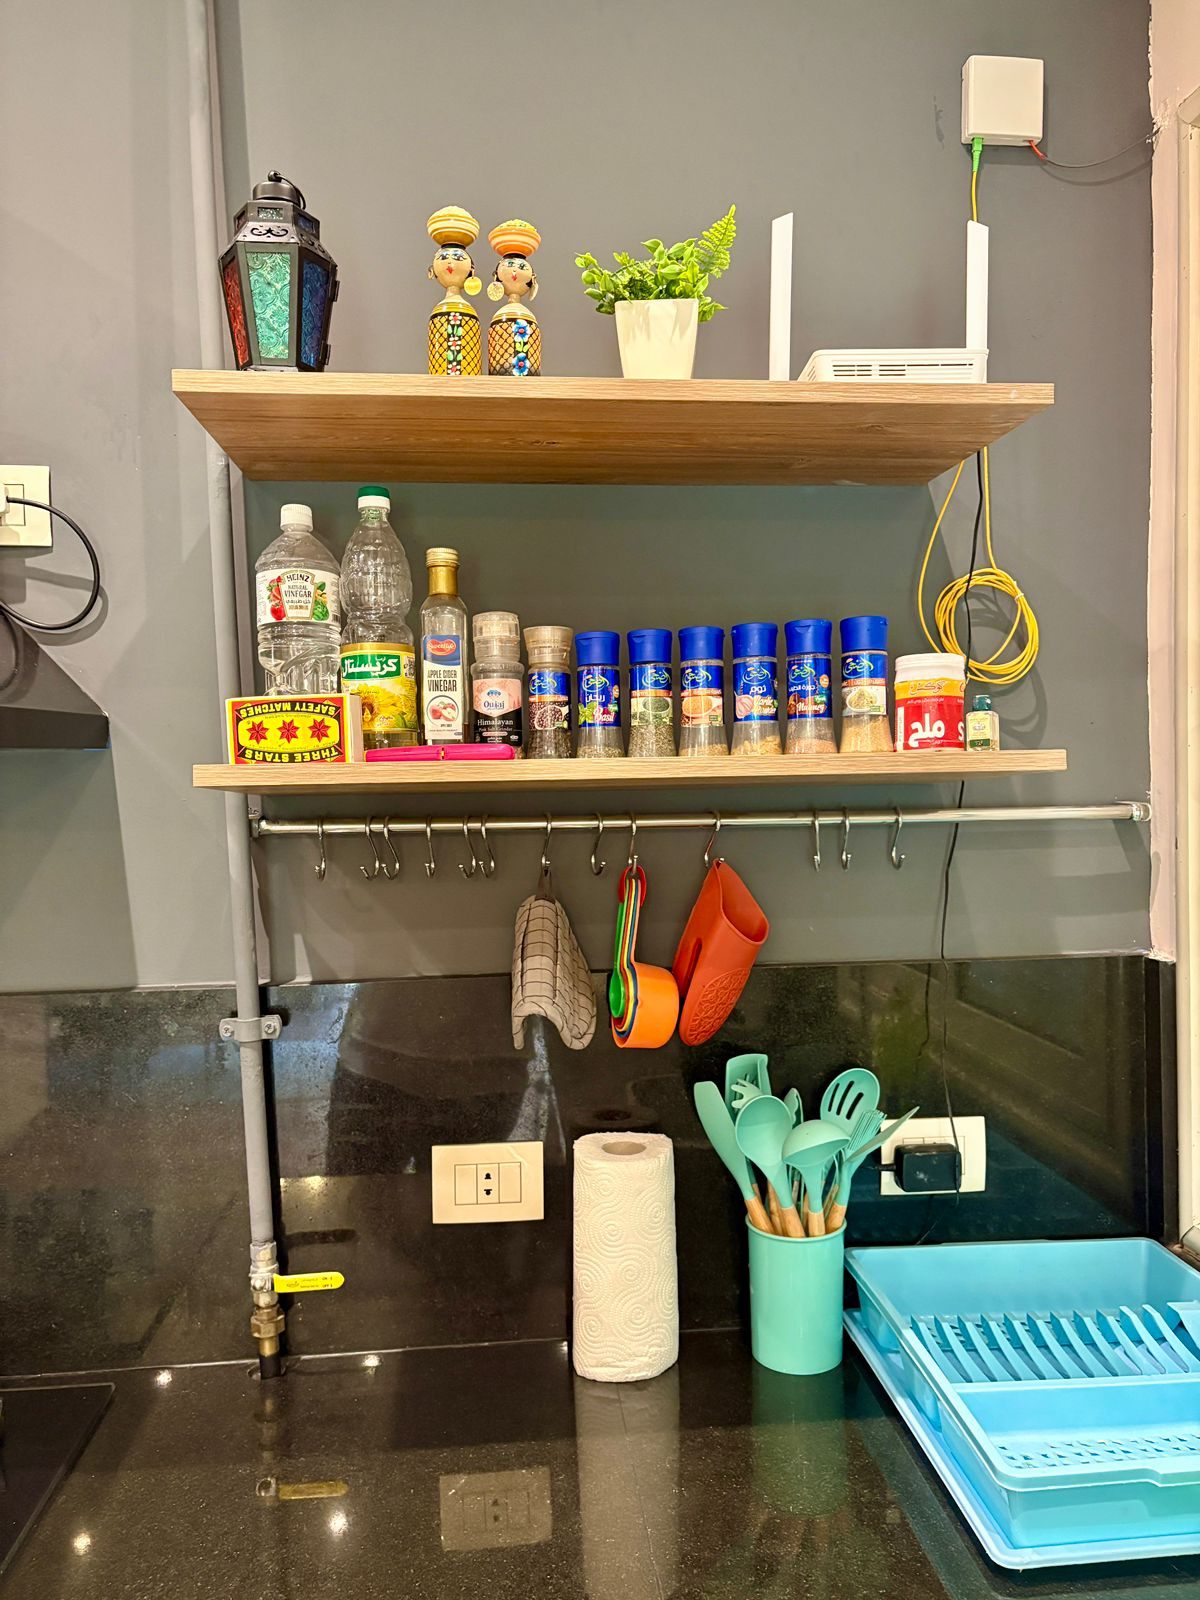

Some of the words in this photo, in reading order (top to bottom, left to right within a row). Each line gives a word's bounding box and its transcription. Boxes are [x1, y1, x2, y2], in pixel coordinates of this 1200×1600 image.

[286, 573, 310, 583] HEINZ
[284, 590, 312, 598] VINEGAR
[342, 656, 399, 677] كريستال
[427, 669, 442, 679] APPLE
[442, 669, 458, 679] CIDER
[427, 679, 458, 692] VINEGAR
[239, 702, 292, 718] MATCHES
[294, 702, 337, 715] SAFETY
[477, 719, 514, 727] Himalayan
[907, 713, 946, 748] ملح
[244, 749, 290, 762] STARS
[294, 747, 339, 762] THREE
